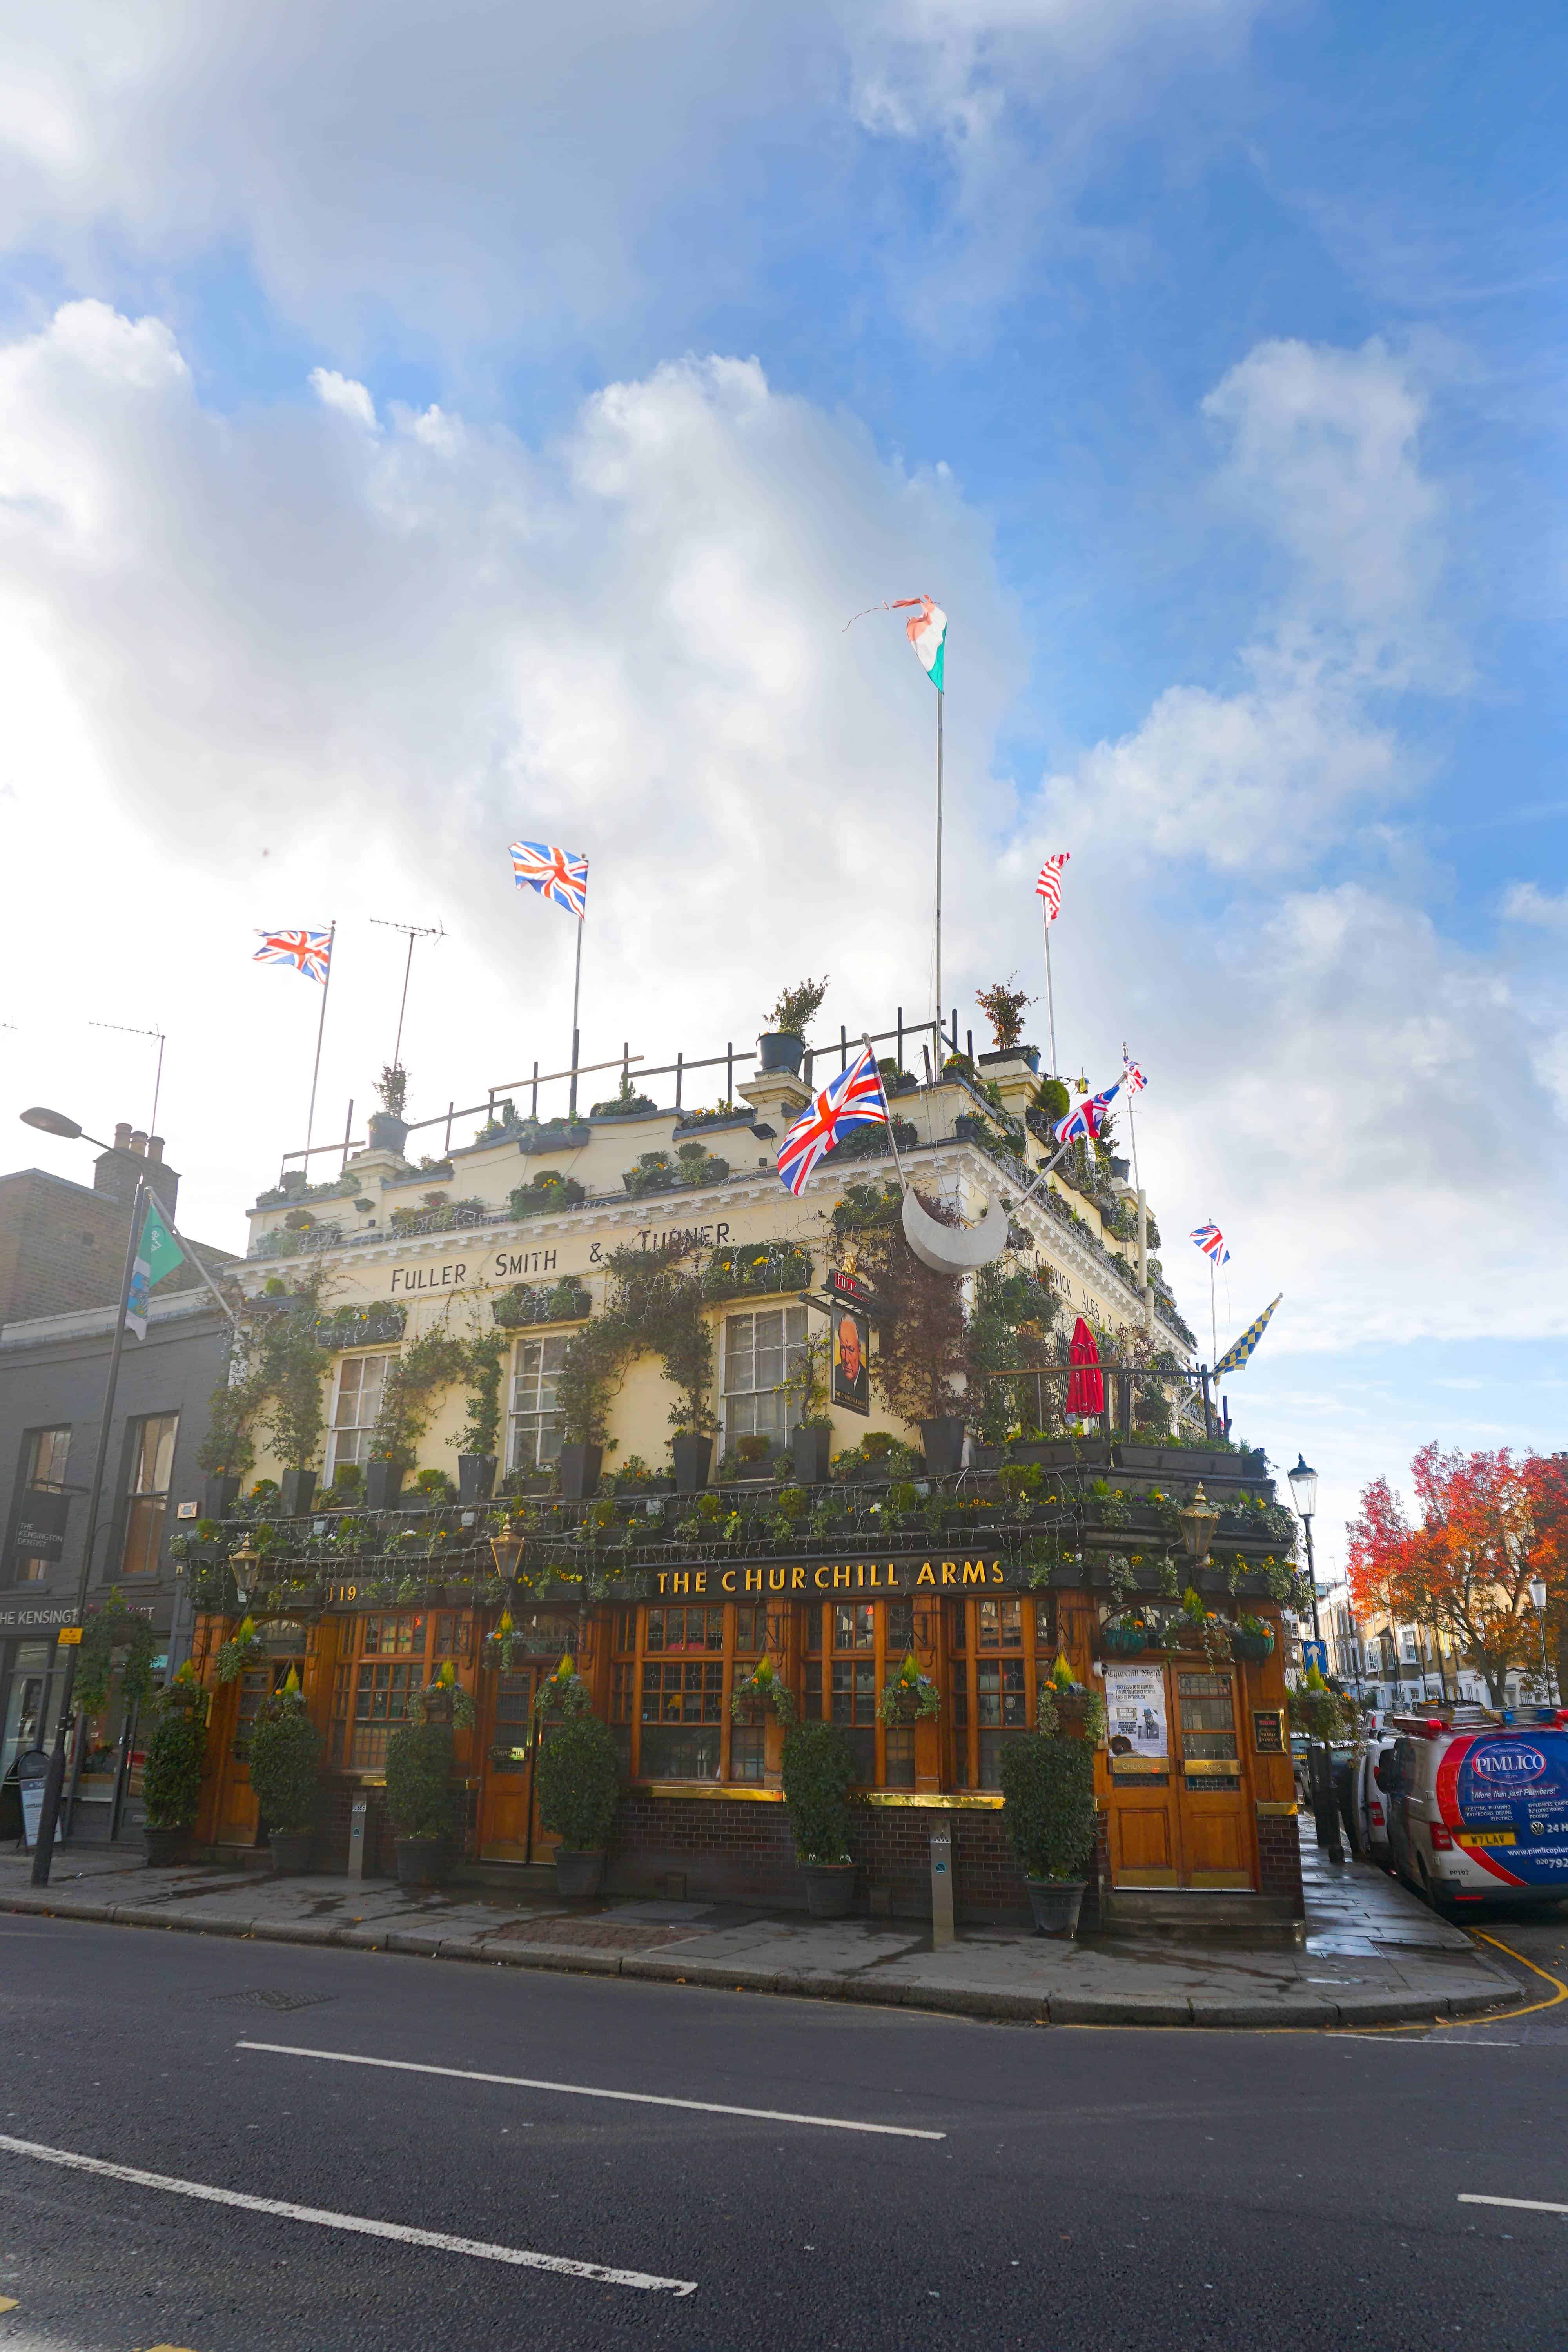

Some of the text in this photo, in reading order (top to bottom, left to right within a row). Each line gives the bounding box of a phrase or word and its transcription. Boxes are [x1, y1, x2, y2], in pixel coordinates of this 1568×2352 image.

[391, 1264, 466, 1292] FULLER
[495, 1249, 557, 1277] SMITH
[590, 1242, 603, 1263] &
[18, 1530, 63, 1542] KENSINGTON
[17, 1538, 46, 1548] DENTIST
[657, 1560, 1004, 1593] THE CHURCHILL ARMS
[329, 1586, 356, 1601] 119
[18, 1609, 79, 1624] KENSINGT
[1108, 1670, 1139, 1679] Churchill
[1476, 1755, 1545, 1772] PIMLICO
[1508, 1788, 1523, 1799] just
[1547, 1824, 1559, 1833] 24
